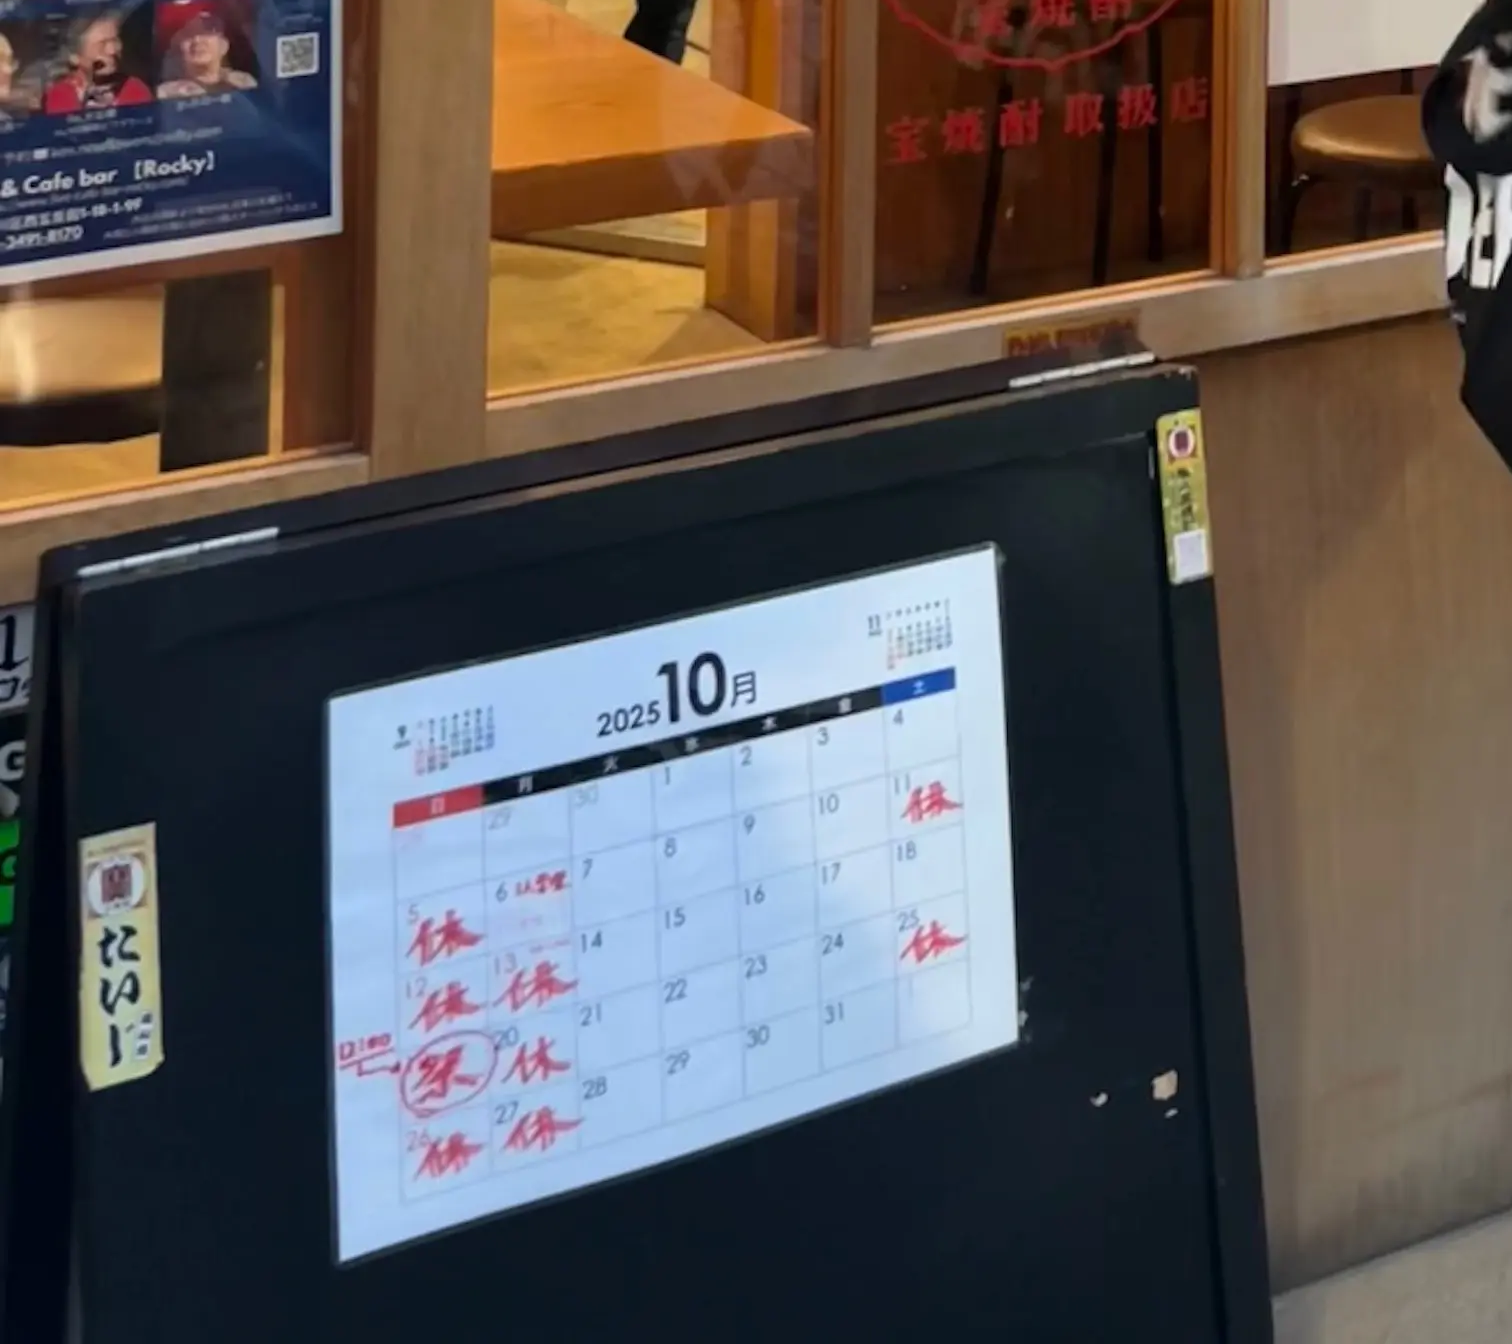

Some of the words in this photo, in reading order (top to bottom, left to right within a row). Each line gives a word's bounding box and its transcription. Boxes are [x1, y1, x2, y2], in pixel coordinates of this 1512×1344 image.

[23, 173, 74, 194] Cafe
[79, 168, 118, 188] bar
[597, 700, 661, 739] 2025
[740, 746, 752, 765] 2
[817, 726, 830, 746] 3
[496, 882, 508, 902] 6
[583, 859, 593, 879] 7
[664, 839, 676, 858] 8
[744, 815, 756, 834] 9
[818, 794, 839, 814] 10
[581, 931, 602, 953] 14
[664, 907, 686, 929] 15
[744, 885, 765, 905] 16
[822, 863, 841, 884] 17
[897, 841, 917, 861] 18
[405, 909, 484, 967] 休
[492, 960, 579, 1012] 休
[580, 1004, 602, 1026] 21
[664, 979, 688, 1003] 22
[744, 958, 767, 978] 23
[821, 933, 844, 955] 24
[897, 910, 920, 931] 25
[495, 1101, 519, 1124] 27
[583, 1076, 608, 1100] 28
[667, 1050, 691, 1075] 29
[746, 1025, 770, 1048] 30
[824, 1002, 844, 1024] 31
[501, 1035, 571, 1085] 休
